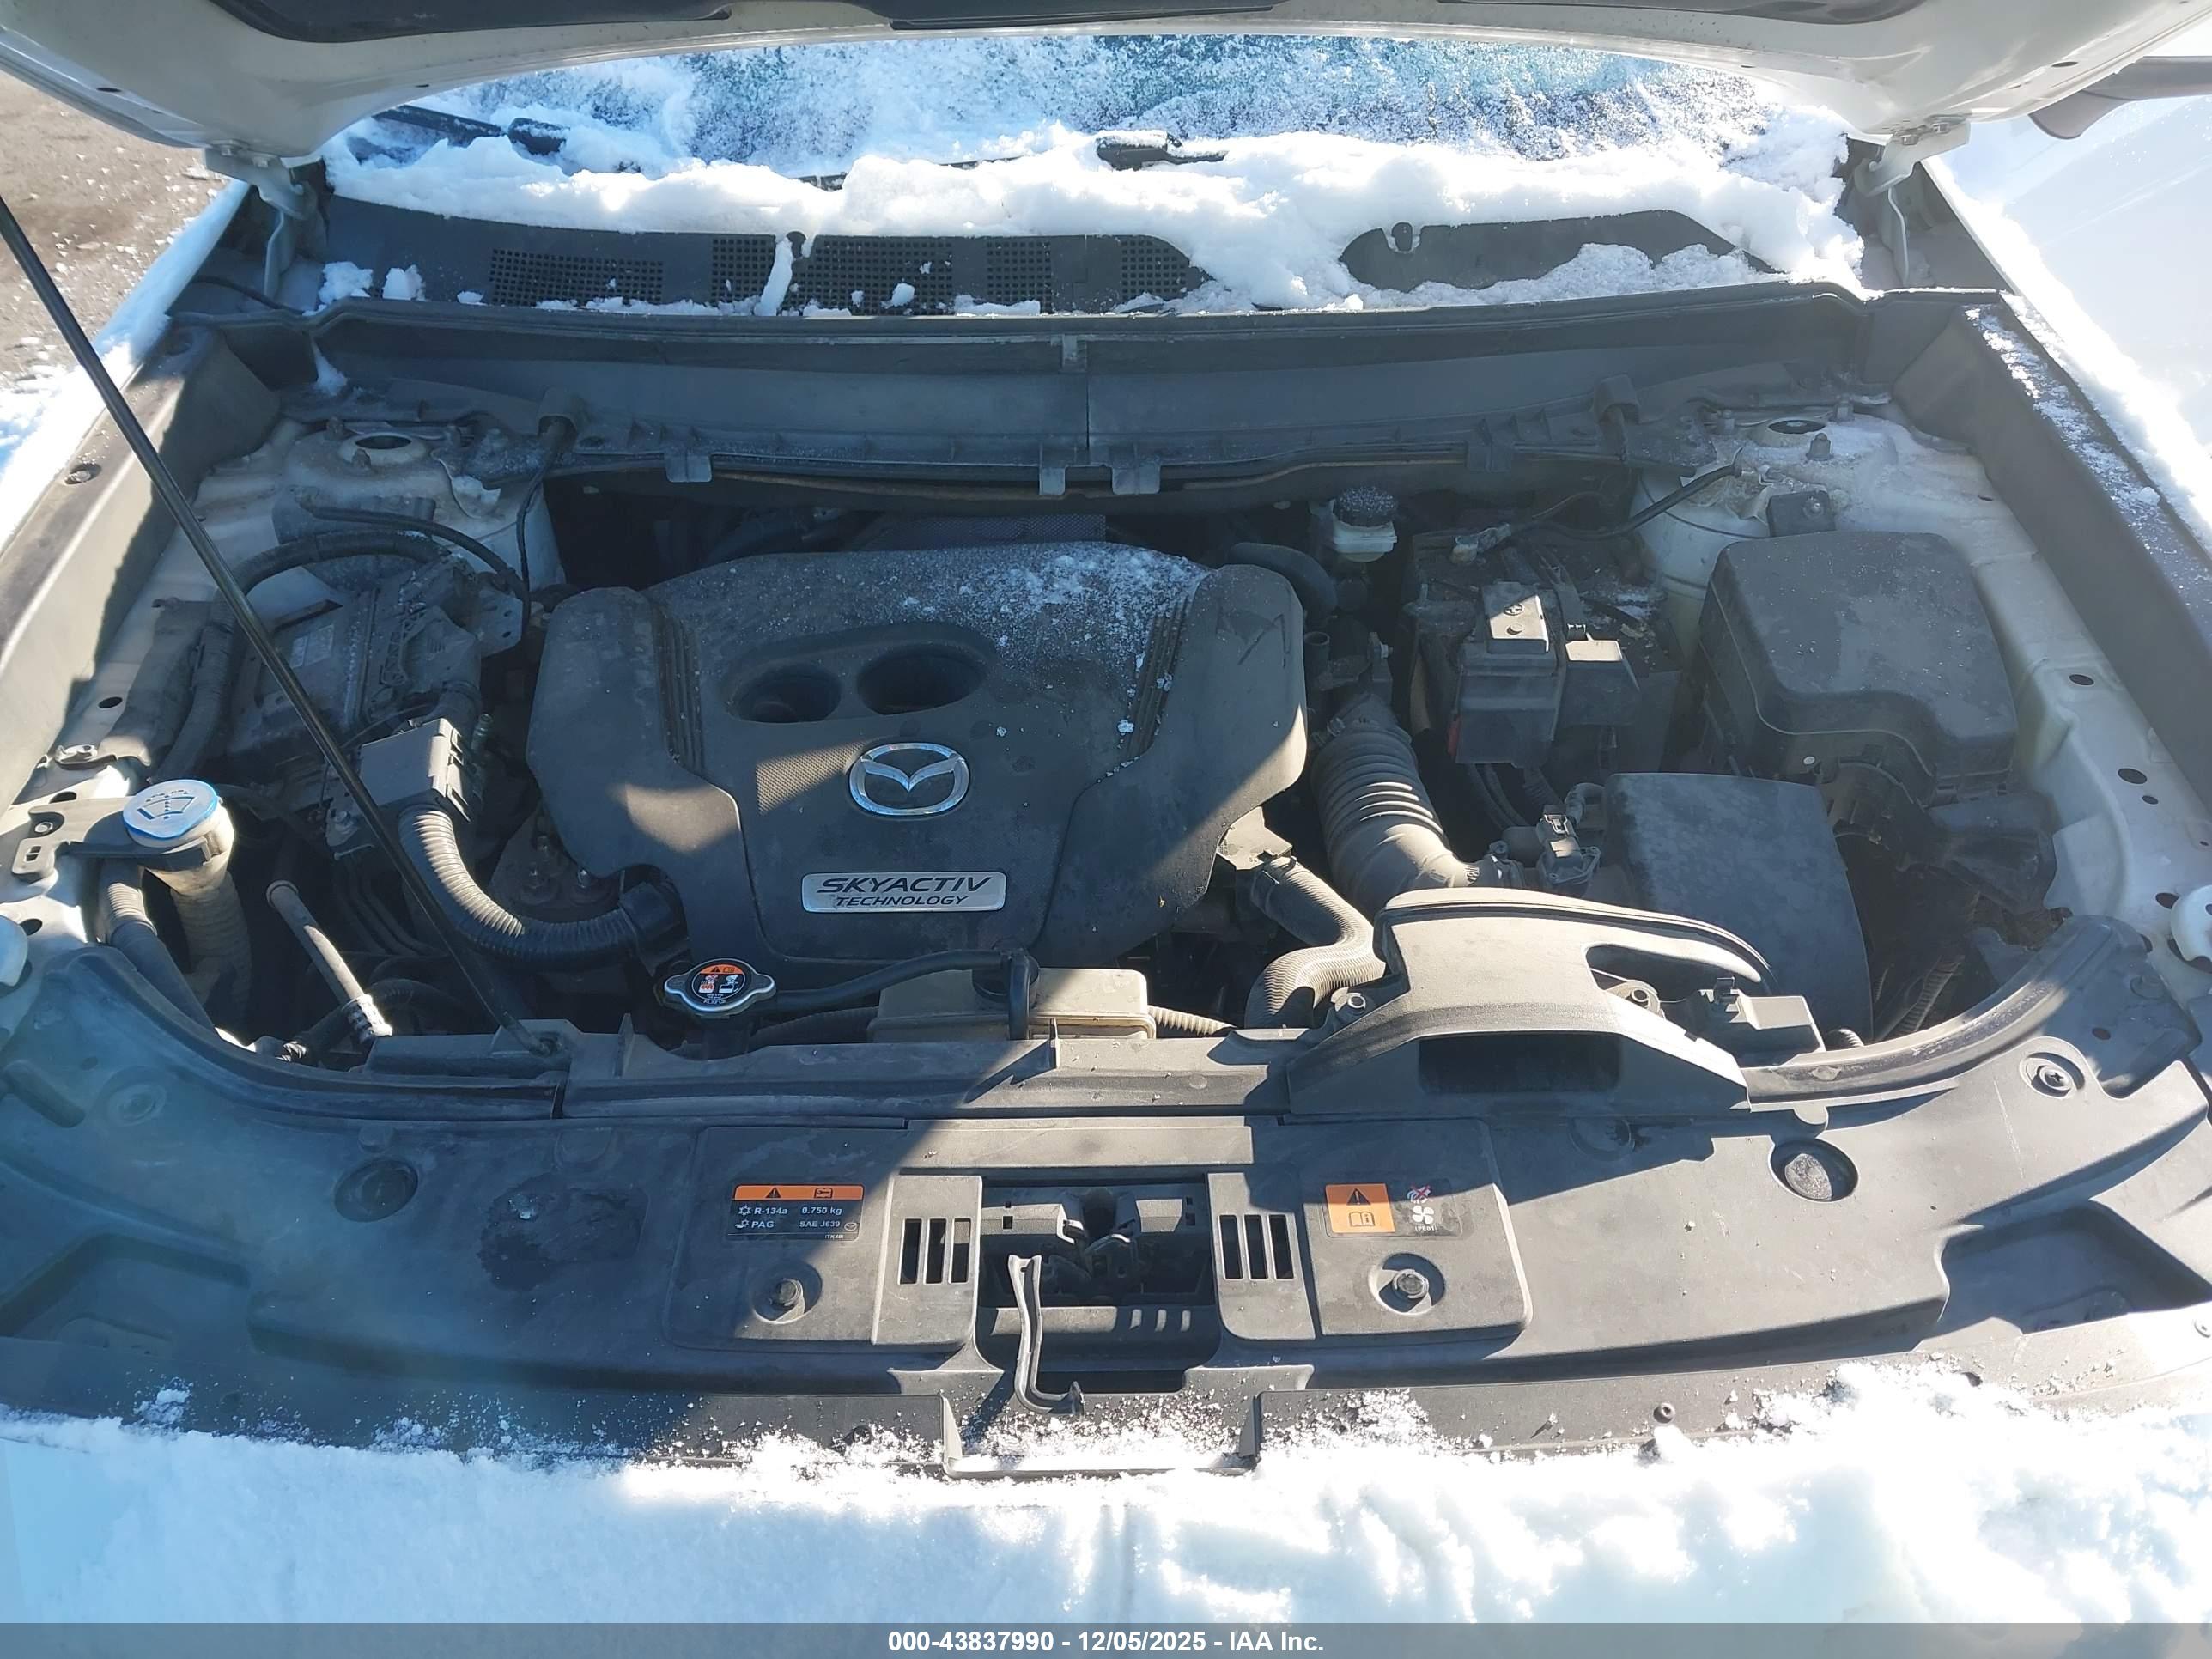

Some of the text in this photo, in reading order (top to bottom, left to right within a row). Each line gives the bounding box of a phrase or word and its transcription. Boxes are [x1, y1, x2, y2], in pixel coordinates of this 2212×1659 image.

[816, 877, 992, 893] SKYACTIV
[836, 896, 969, 907] TECHNOLOGY
[754, 1206, 788, 1215] R-134a
[830, 1206, 842, 1216] kg
[750, 1220, 775, 1229] PAG
